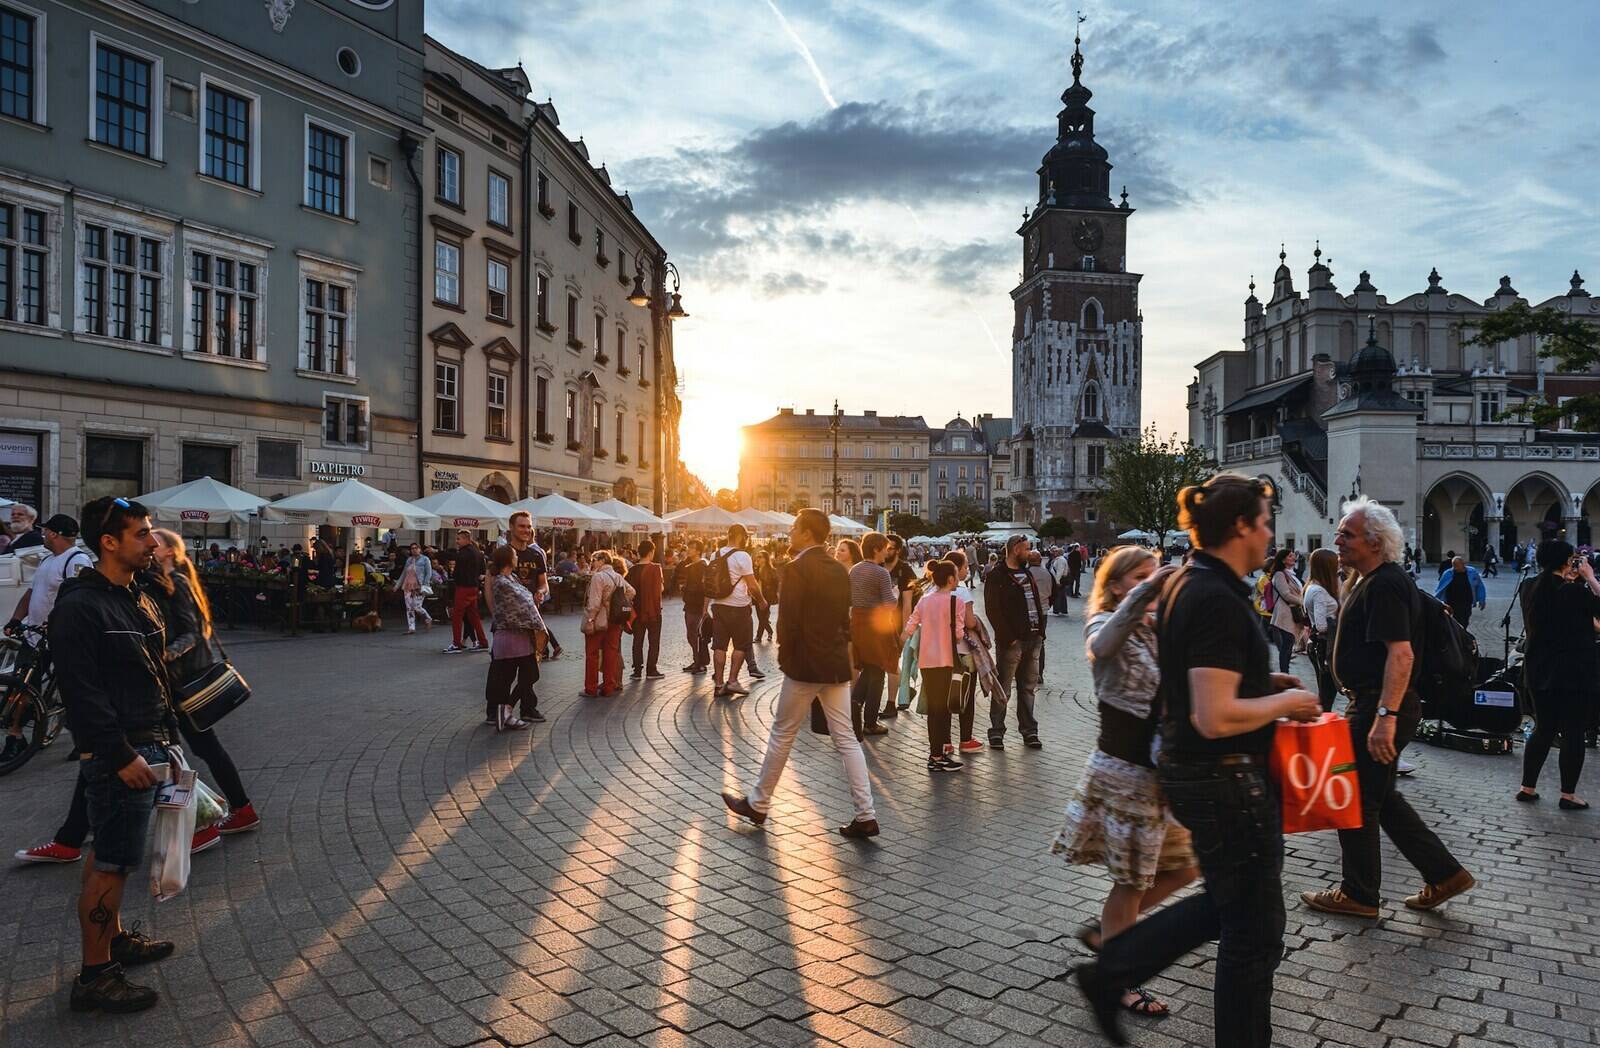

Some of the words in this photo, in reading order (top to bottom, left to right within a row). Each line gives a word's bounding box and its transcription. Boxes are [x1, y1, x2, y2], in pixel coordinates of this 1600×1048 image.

[311, 462, 326, 473] DA
[328, 463, 365, 476] PIETRO
[1288, 747, 1353, 816] %
